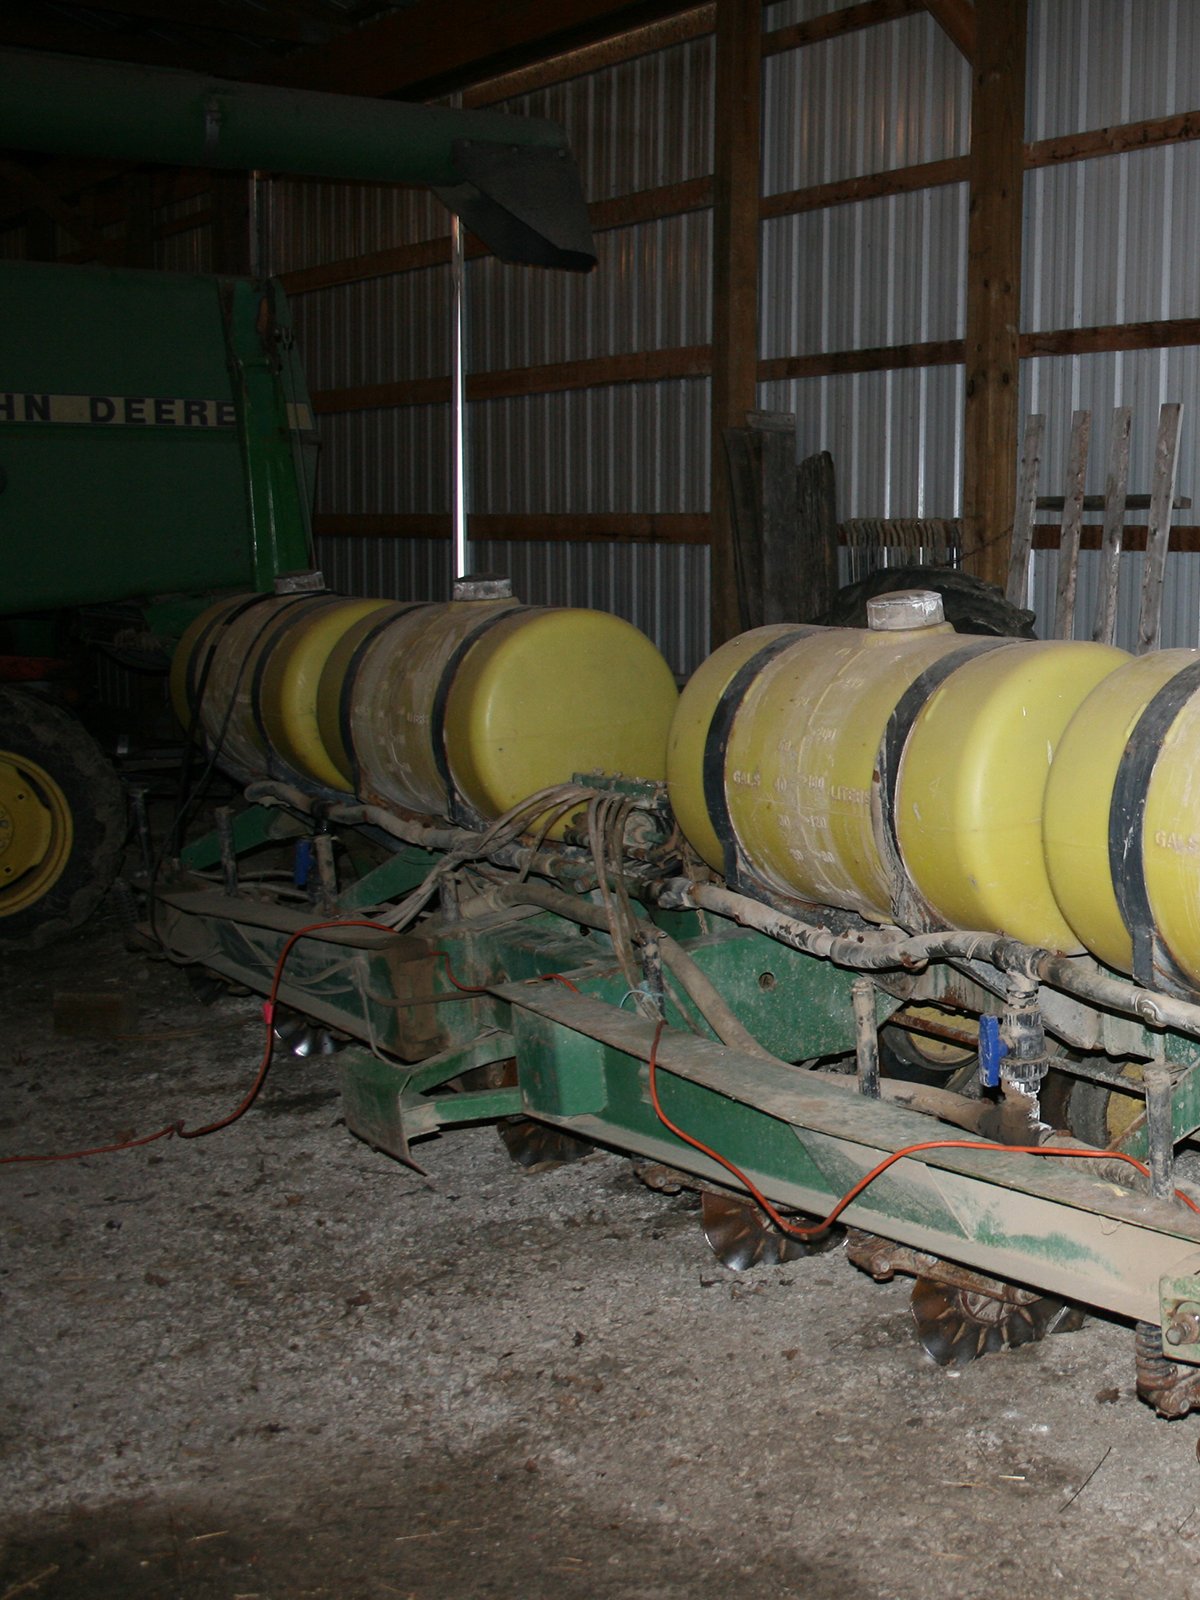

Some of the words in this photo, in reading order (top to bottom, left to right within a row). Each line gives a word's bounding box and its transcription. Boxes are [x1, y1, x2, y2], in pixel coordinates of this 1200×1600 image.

[90, 397, 236, 426] DEERE
[732, 769, 761, 787] GALS
[1154, 831, 1200, 853] GALS
